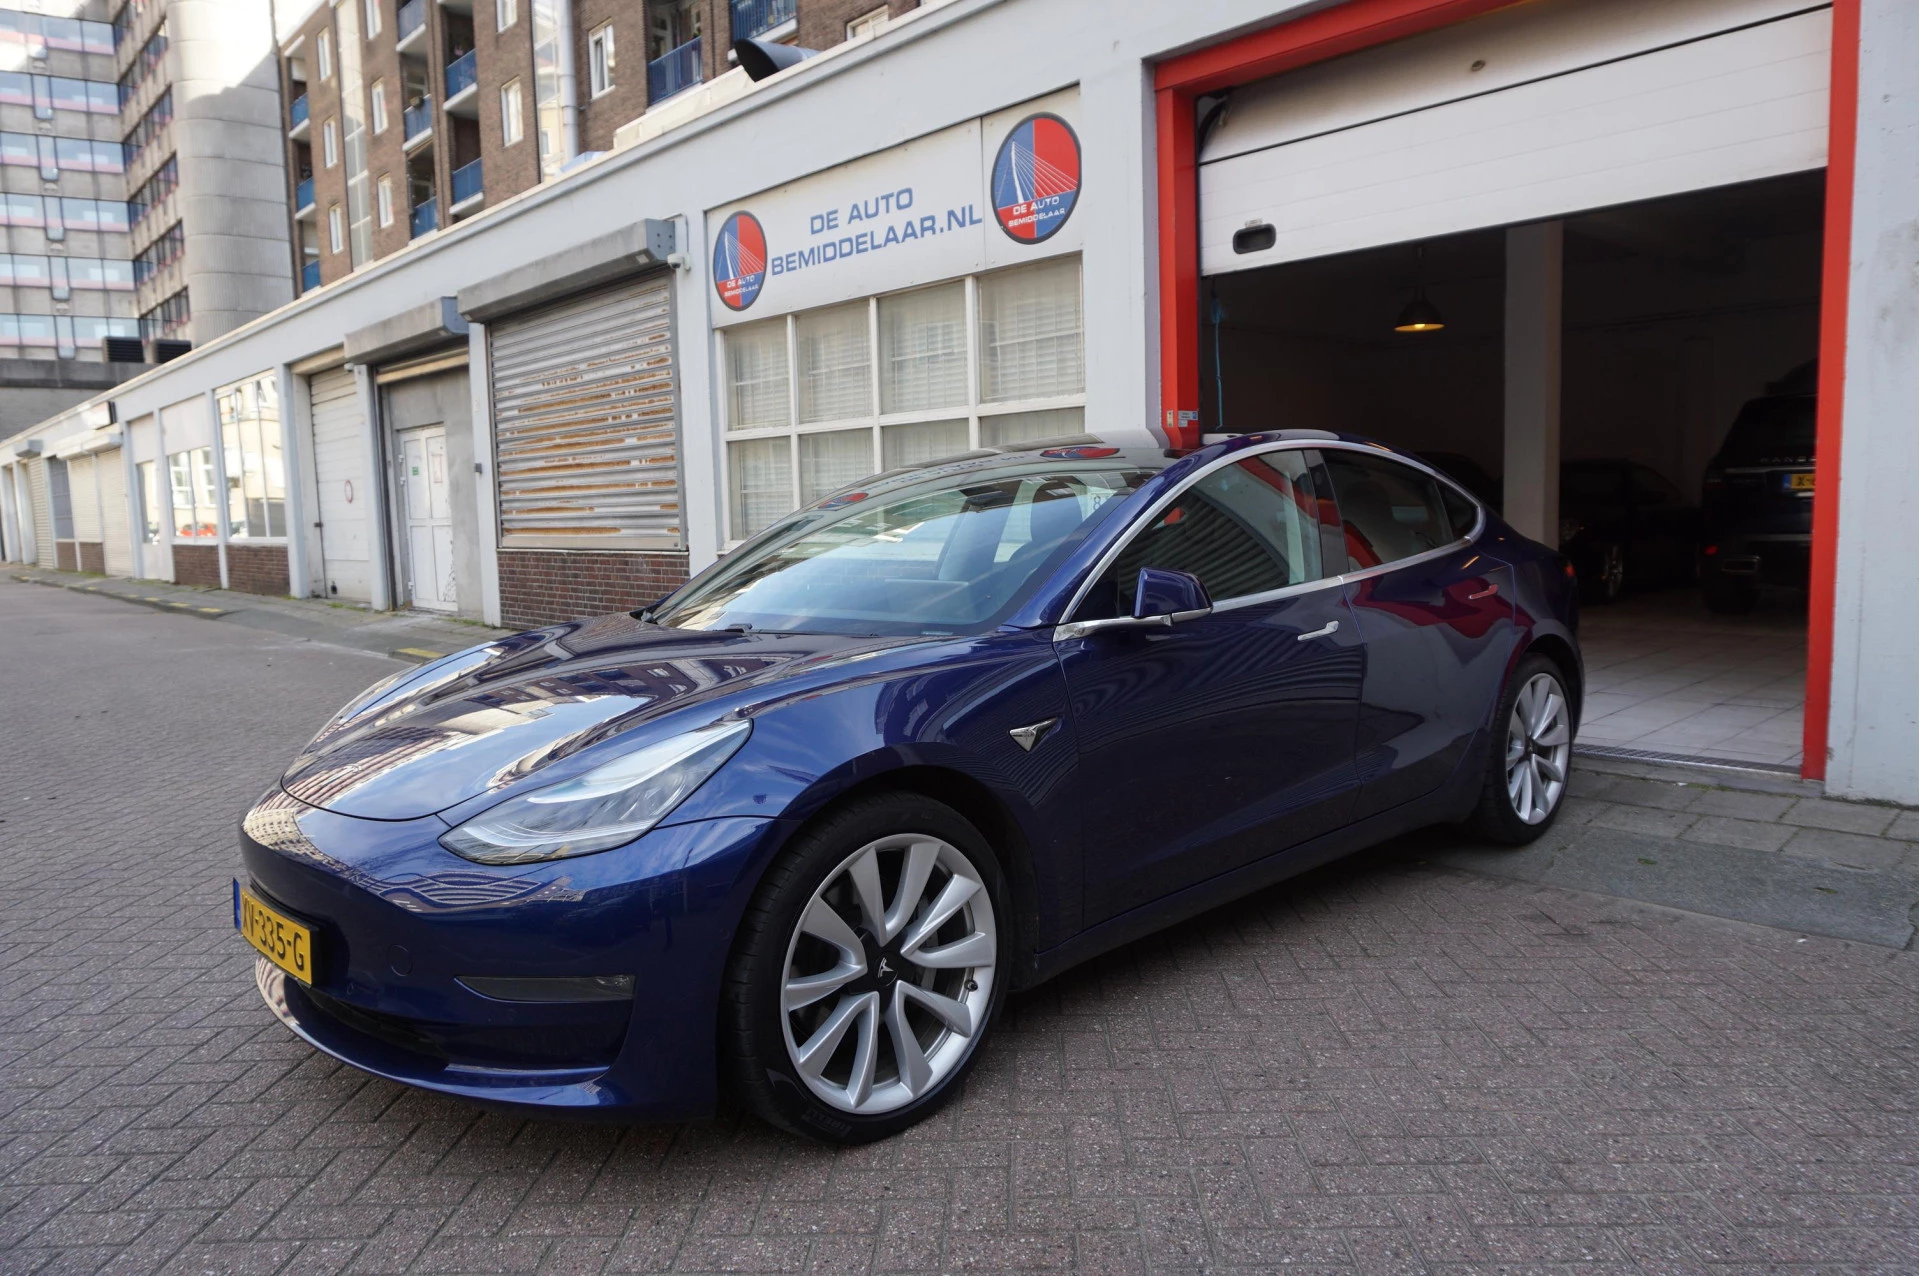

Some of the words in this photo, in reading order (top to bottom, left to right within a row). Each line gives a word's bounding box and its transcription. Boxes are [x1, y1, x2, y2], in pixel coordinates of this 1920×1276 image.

[810, 209, 839, 235] DE
[847, 187, 913, 225] AUTO
[1012, 204, 1027, 216] DE
[1030, 196, 1060, 212] AUTO
[1008, 207, 1066, 228] BEMIDDELAAR
[771, 203, 983, 276] BEMIDDELAAR.NL
[724, 284, 759, 298] BEMIDDELAAR
[726, 279, 736, 289] DE
[737, 275, 755, 286] AUTO
[242, 896, 305, 972] XV-335-G
